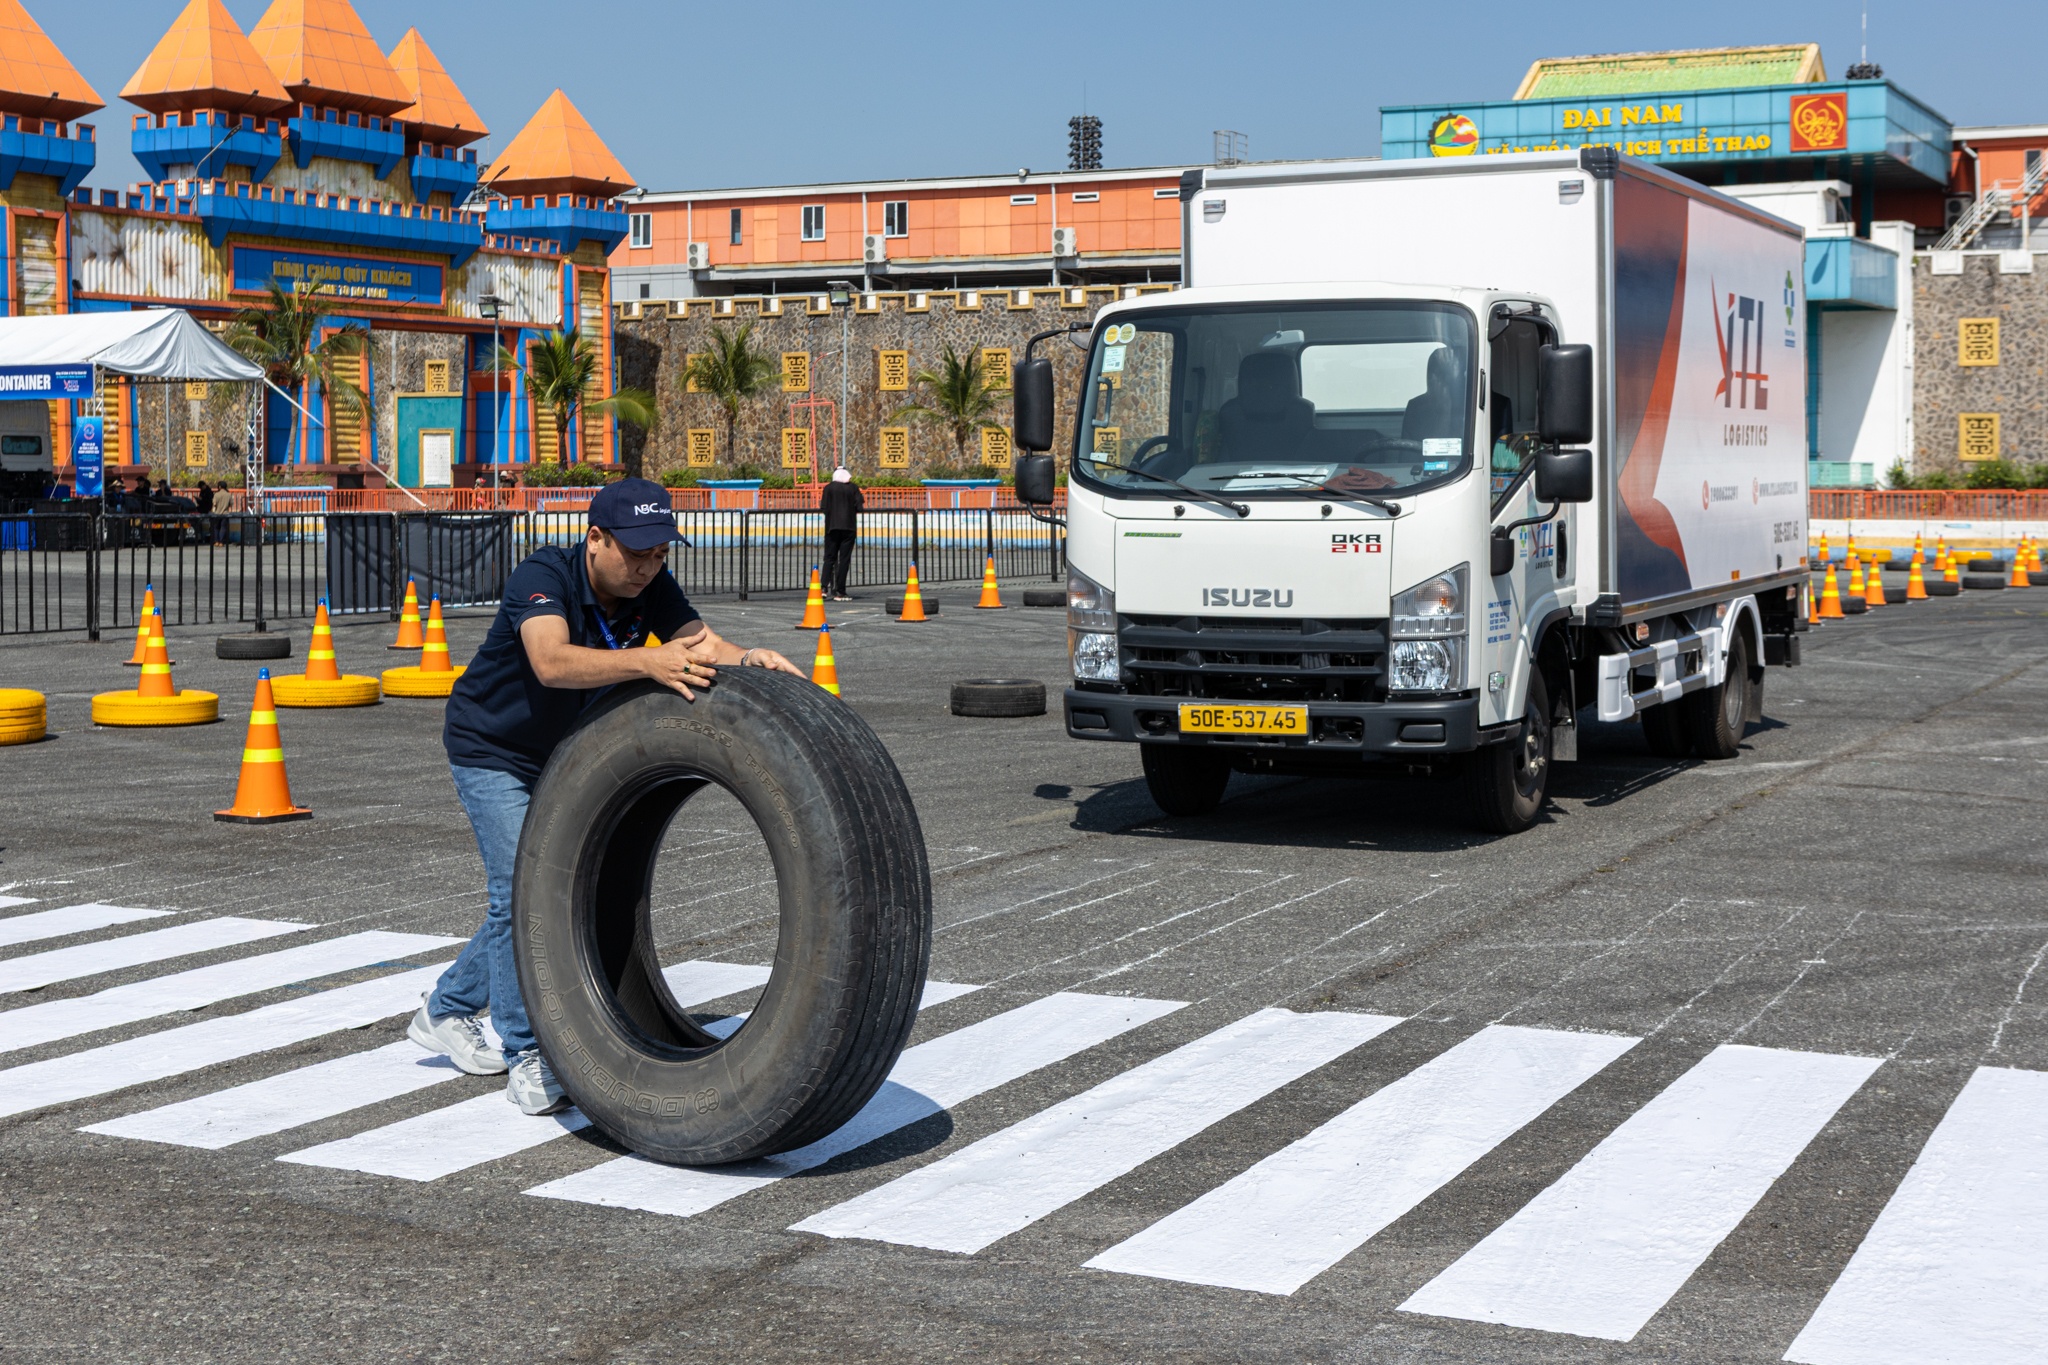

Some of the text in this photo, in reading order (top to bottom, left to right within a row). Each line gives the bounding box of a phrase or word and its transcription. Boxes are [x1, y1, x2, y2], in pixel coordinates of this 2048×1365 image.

[1563, 104, 1683, 132] ĐẠI NAM
[1667, 126, 1710, 154] THỂ
[1712, 134, 1772, 152] THAO
[371, 266, 412, 287] KHÁCH
[1724, 424, 1768, 446] LOGISTICS
[634, 502, 658, 516] NBC
[1331, 534, 1381, 543] QKR
[1331, 544, 1381, 553] 210
[1202, 588, 1293, 608] ISUZU
[1190, 709, 1296, 729] 50E-537.45
[653, 717, 733, 748] 11R22.5
[527, 913, 564, 1022] COIN
[556, 1027, 687, 1118] DOUBLE
